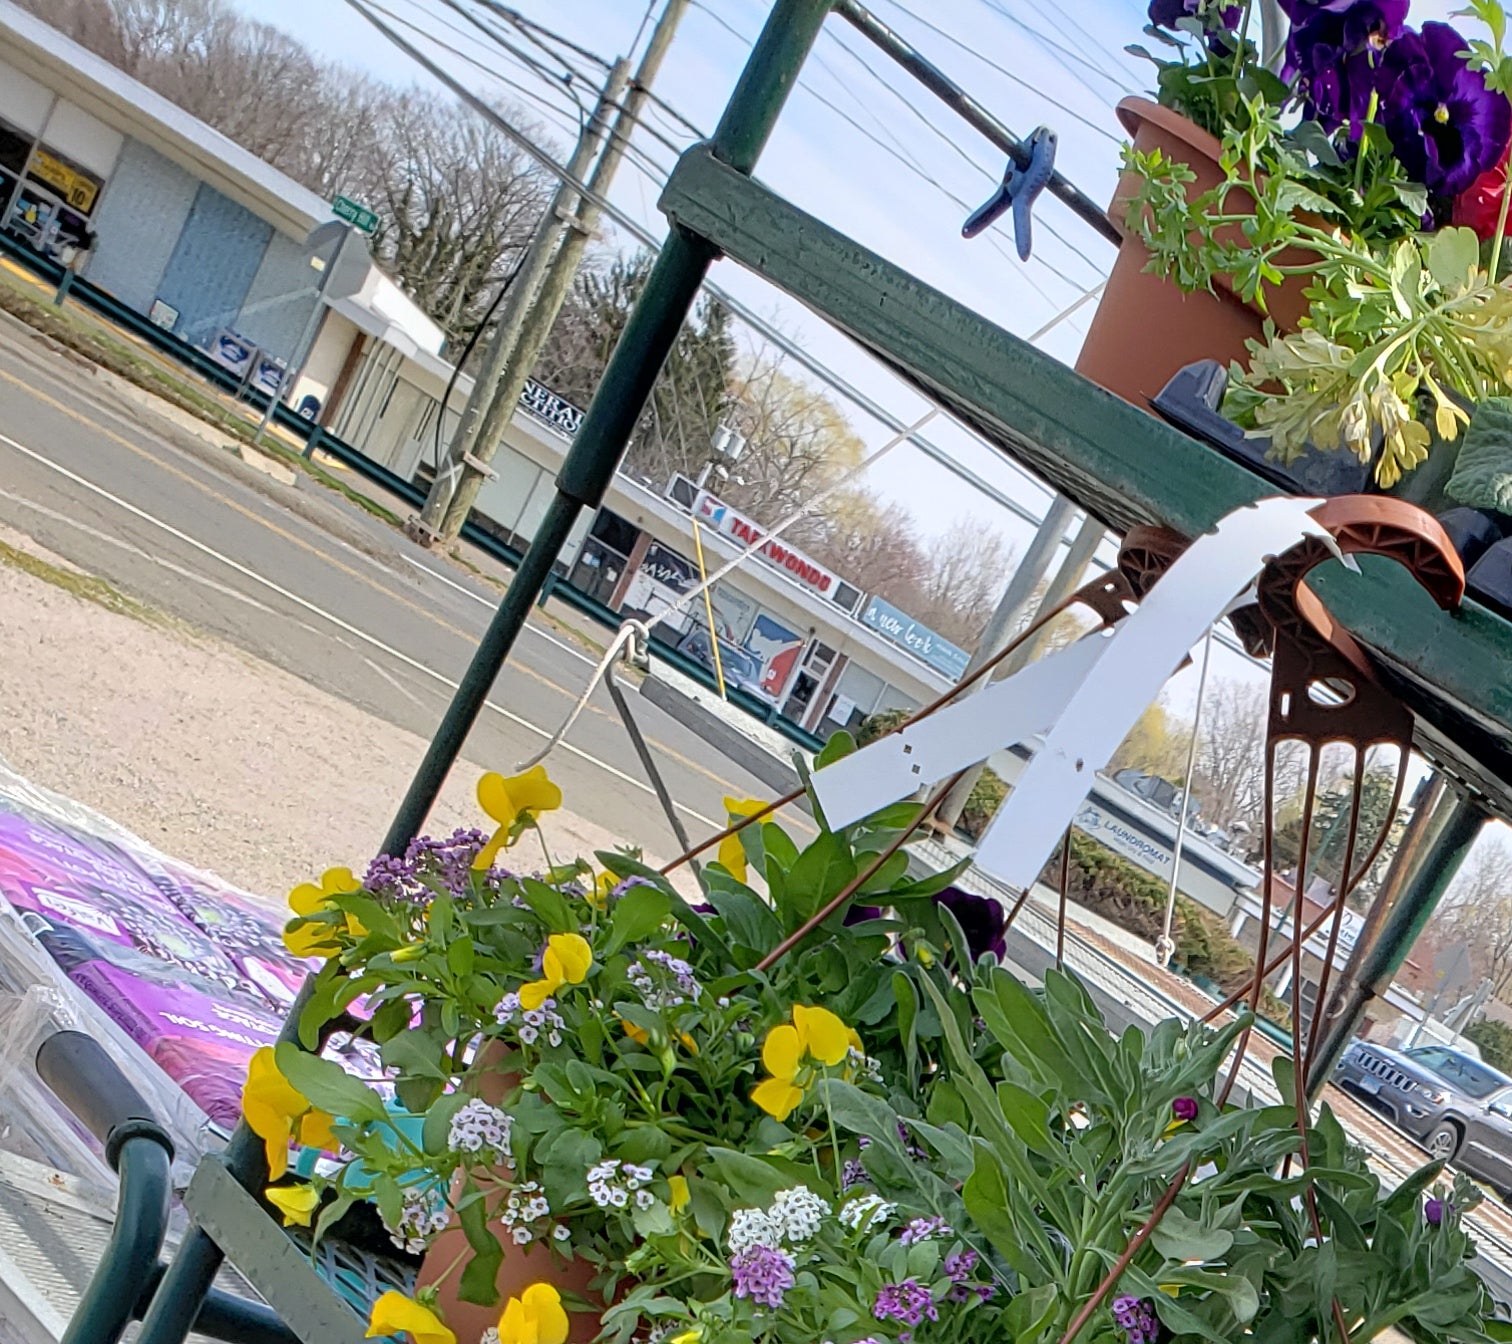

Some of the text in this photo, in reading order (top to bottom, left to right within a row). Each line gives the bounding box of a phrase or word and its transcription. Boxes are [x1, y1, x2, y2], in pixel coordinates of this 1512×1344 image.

[520, 392, 578, 431] CTITIO
[524, 381, 584, 425] NERAL
[1104, 821, 1171, 864] LAUNDROMAT
